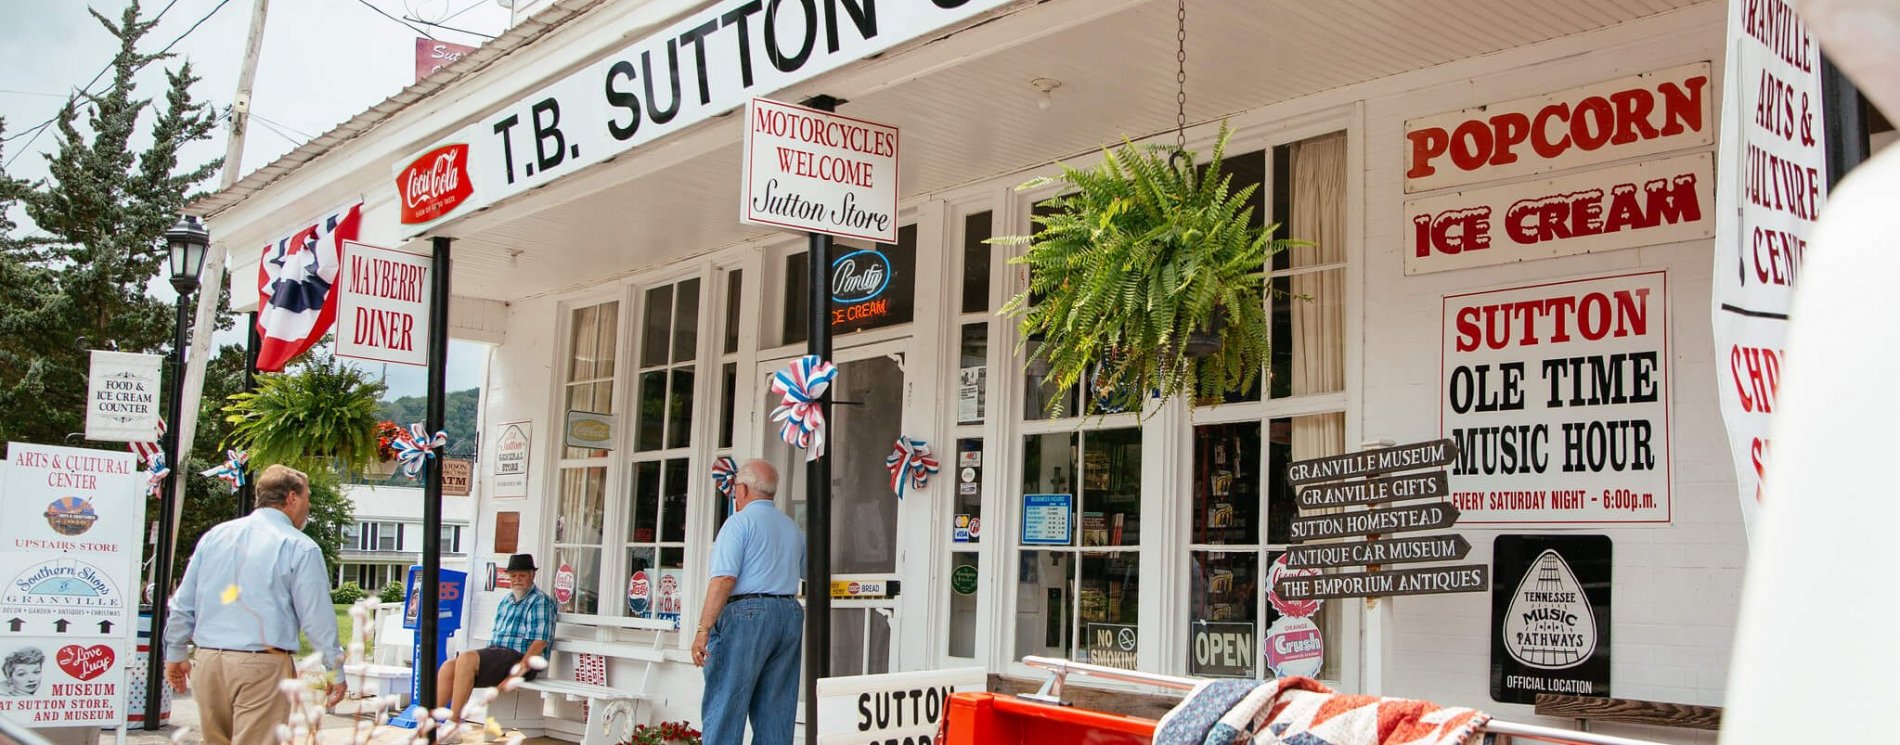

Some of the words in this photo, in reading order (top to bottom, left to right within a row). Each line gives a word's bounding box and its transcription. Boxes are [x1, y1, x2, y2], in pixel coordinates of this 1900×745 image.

[494, 97, 580, 184] T.B.
[604, 0, 878, 142] SUTTON
[1756, 68, 1794, 141] ARTS
[1800, 92, 1815, 147] &
[755, 107, 894, 158] MOTORCYCLES
[1406, 75, 1707, 179] POPCORN
[777, 146, 873, 188] WELCOME
[1745, 140, 1819, 222] CULTURE
[753, 178, 828, 222] Sutton
[830, 192, 891, 232] Store
[1413, 205, 1492, 258] ICE
[1504, 173, 1702, 245] CREAM
[1753, 226, 1807, 288] CENT
[349, 255, 427, 303] MAYBERRY
[847, 299, 887, 321] CREAM
[1456, 288, 1650, 352] SUTTON
[353, 306, 413, 352] DINER
[106, 380, 133, 391] FOOD
[135, 382, 145, 391] &
[1450, 361, 1525, 414] OLE
[1542, 351, 1658, 408] TIME
[97, 391, 113, 401] ICE
[116, 392, 152, 403] CREAM
[99, 402, 148, 413] COUNTER
[1452, 424, 1549, 475] MUSIC
[1562, 419, 1655, 472] HOUR
[15, 451, 48, 469] ARTS
[52, 454, 62, 469] &
[66, 455, 130, 475] CULTURAL
[1289, 455, 1375, 482] GRANVILLE
[1378, 444, 1445, 468] MUSEUM
[48, 472, 97, 490] CENTER
[1302, 482, 1388, 505] GRANVILLE
[1392, 477, 1437, 497] GIFTS
[1452, 491, 1485, 510] EVERY
[1490, 490, 1546, 510] SATURDAY
[1551, 490, 1586, 510] NIGHT
[1603, 489, 1657, 512] 6:00p.m.
[1291, 518, 1344, 538] SUTTON
[1346, 507, 1443, 531] HOMESTEAD
[15, 539, 75, 550] UPSTAIRS
[80, 542, 118, 552] STORE
[1289, 547, 1350, 566] ANTIQUE
[1352, 544, 1385, 561] CAR
[1390, 539, 1456, 560] MUSEUM
[16, 565, 76, 592] Southern
[78, 566, 110, 596] Shops
[861, 584, 880, 593] BREAD
[1282, 580, 1310, 597] THE
[1314, 574, 1394, 595] EMPORIUM
[1398, 569, 1481, 591] ANTIQUES
[7, 595, 119, 606] GRANVILLE
[1524, 591, 1576, 603] TENNESSEE
[1522, 608, 1578, 627] MUSIC
[1097, 629, 1112, 648] NO
[1195, 632, 1251, 666] OPEN
[1275, 633, 1320, 654] Crush
[1516, 632, 1584, 647] PATHWAYS
[73, 648, 103, 667] Love
[79, 657, 112, 679] Lucy
[52, 683, 116, 696] MUSEUM
[1507, 675, 1546, 691] OFFICIAL
[1548, 677, 1592, 694] LOCATION
[0, 701, 13, 710] AT
[17, 700, 66, 710] SUTTON
[34, 711, 59, 721] AND
[64, 710, 114, 721] MUSEUM
